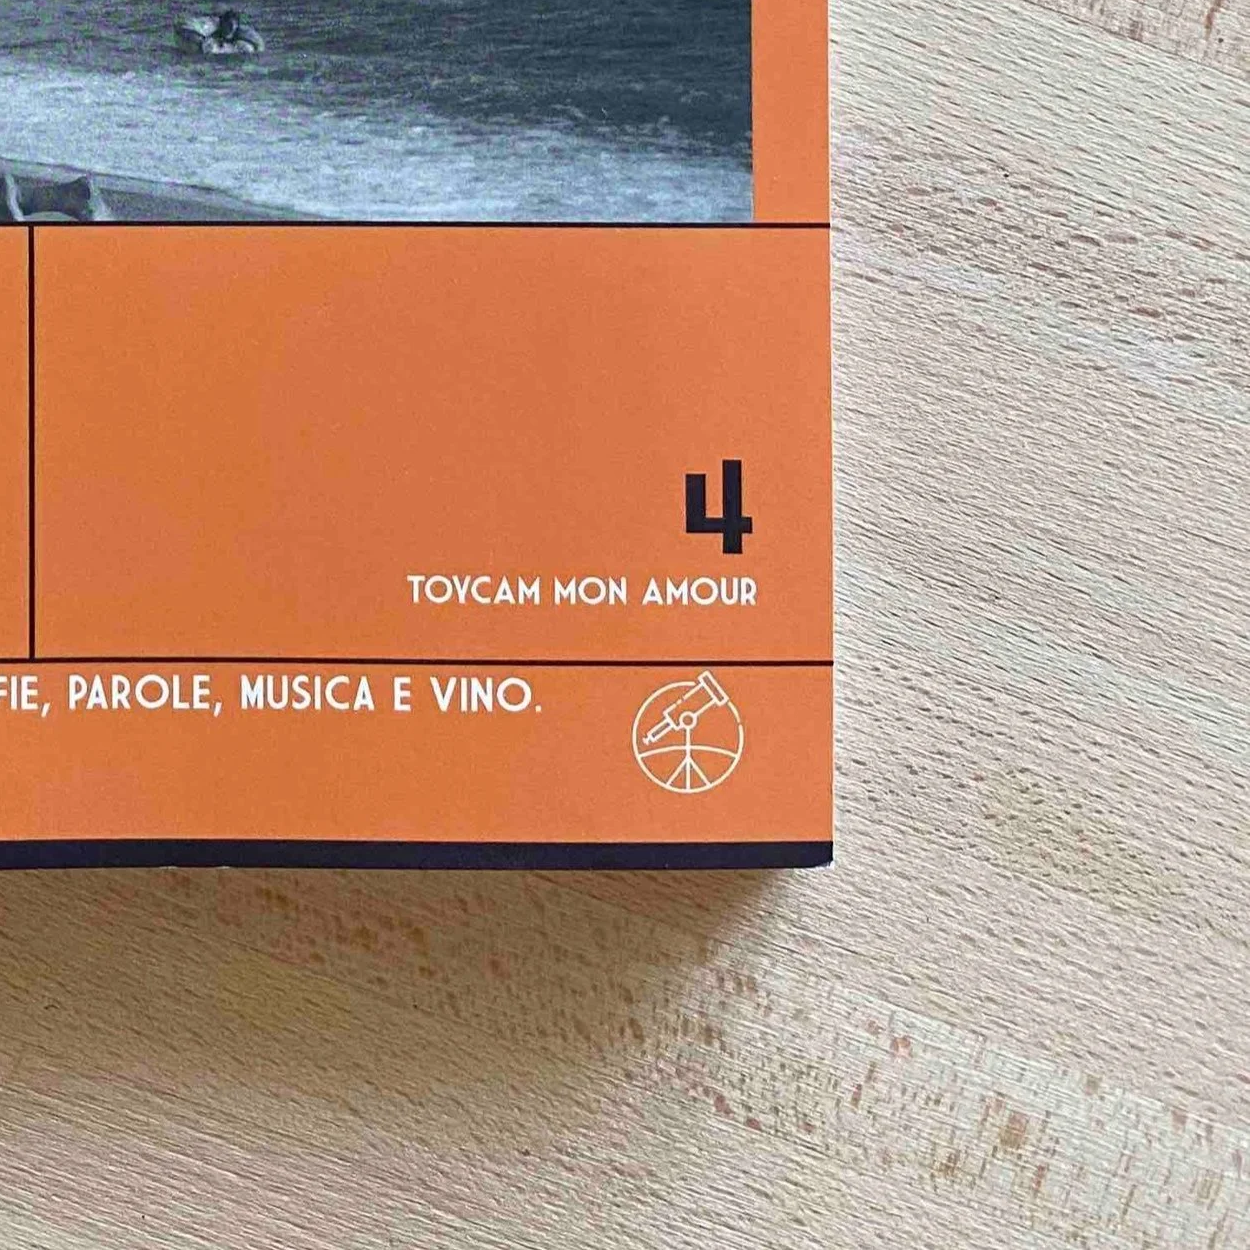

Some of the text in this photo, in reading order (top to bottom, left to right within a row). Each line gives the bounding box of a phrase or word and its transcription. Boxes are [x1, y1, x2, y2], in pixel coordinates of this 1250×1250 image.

[686, 460, 753, 555] 4
[406, 575, 757, 606] TOYCAM MON AMOUR
[68, 674, 223, 717] PAROLE,
[240, 674, 375, 711] MUSICA
[393, 676, 412, 712] E
[429, 676, 543, 713] VINO.
